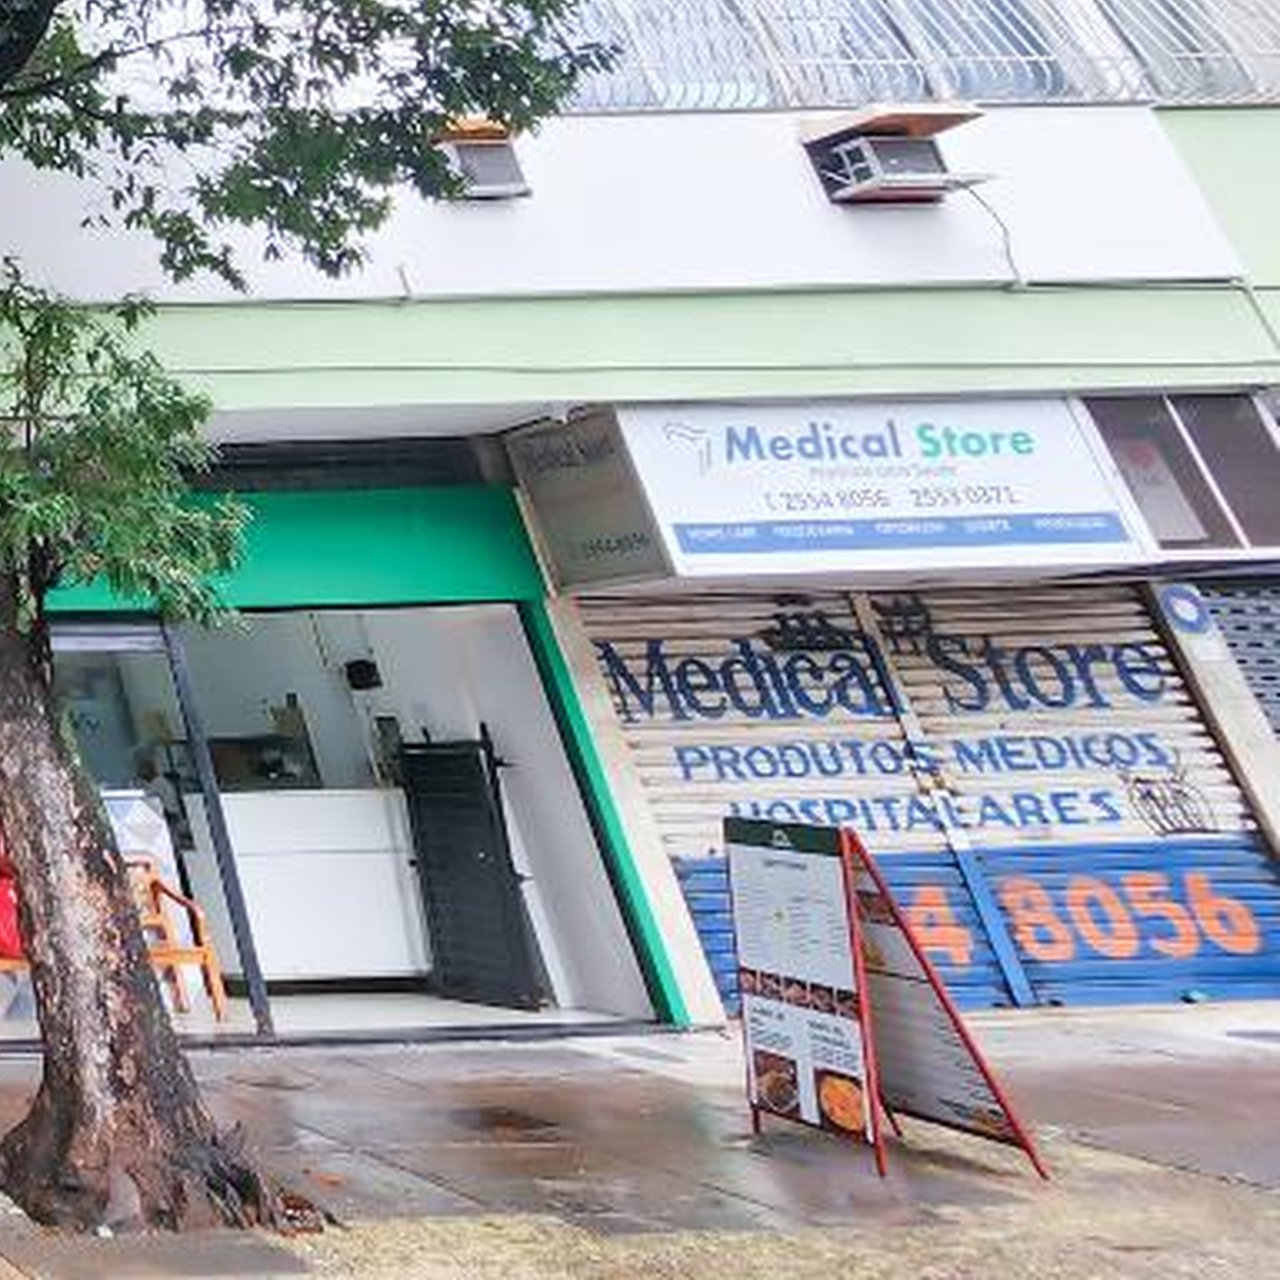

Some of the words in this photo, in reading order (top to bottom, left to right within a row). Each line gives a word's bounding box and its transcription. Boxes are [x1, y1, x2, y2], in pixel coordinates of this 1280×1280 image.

[724, 420, 902, 462] Medical
[915, 423, 1035, 458] Store
[597, 634, 905, 720] Medical
[926, 631, 1168, 714] Store
[673, 742, 940, 781] PRODUTOS
[998, 871, 1262, 961] 8056
